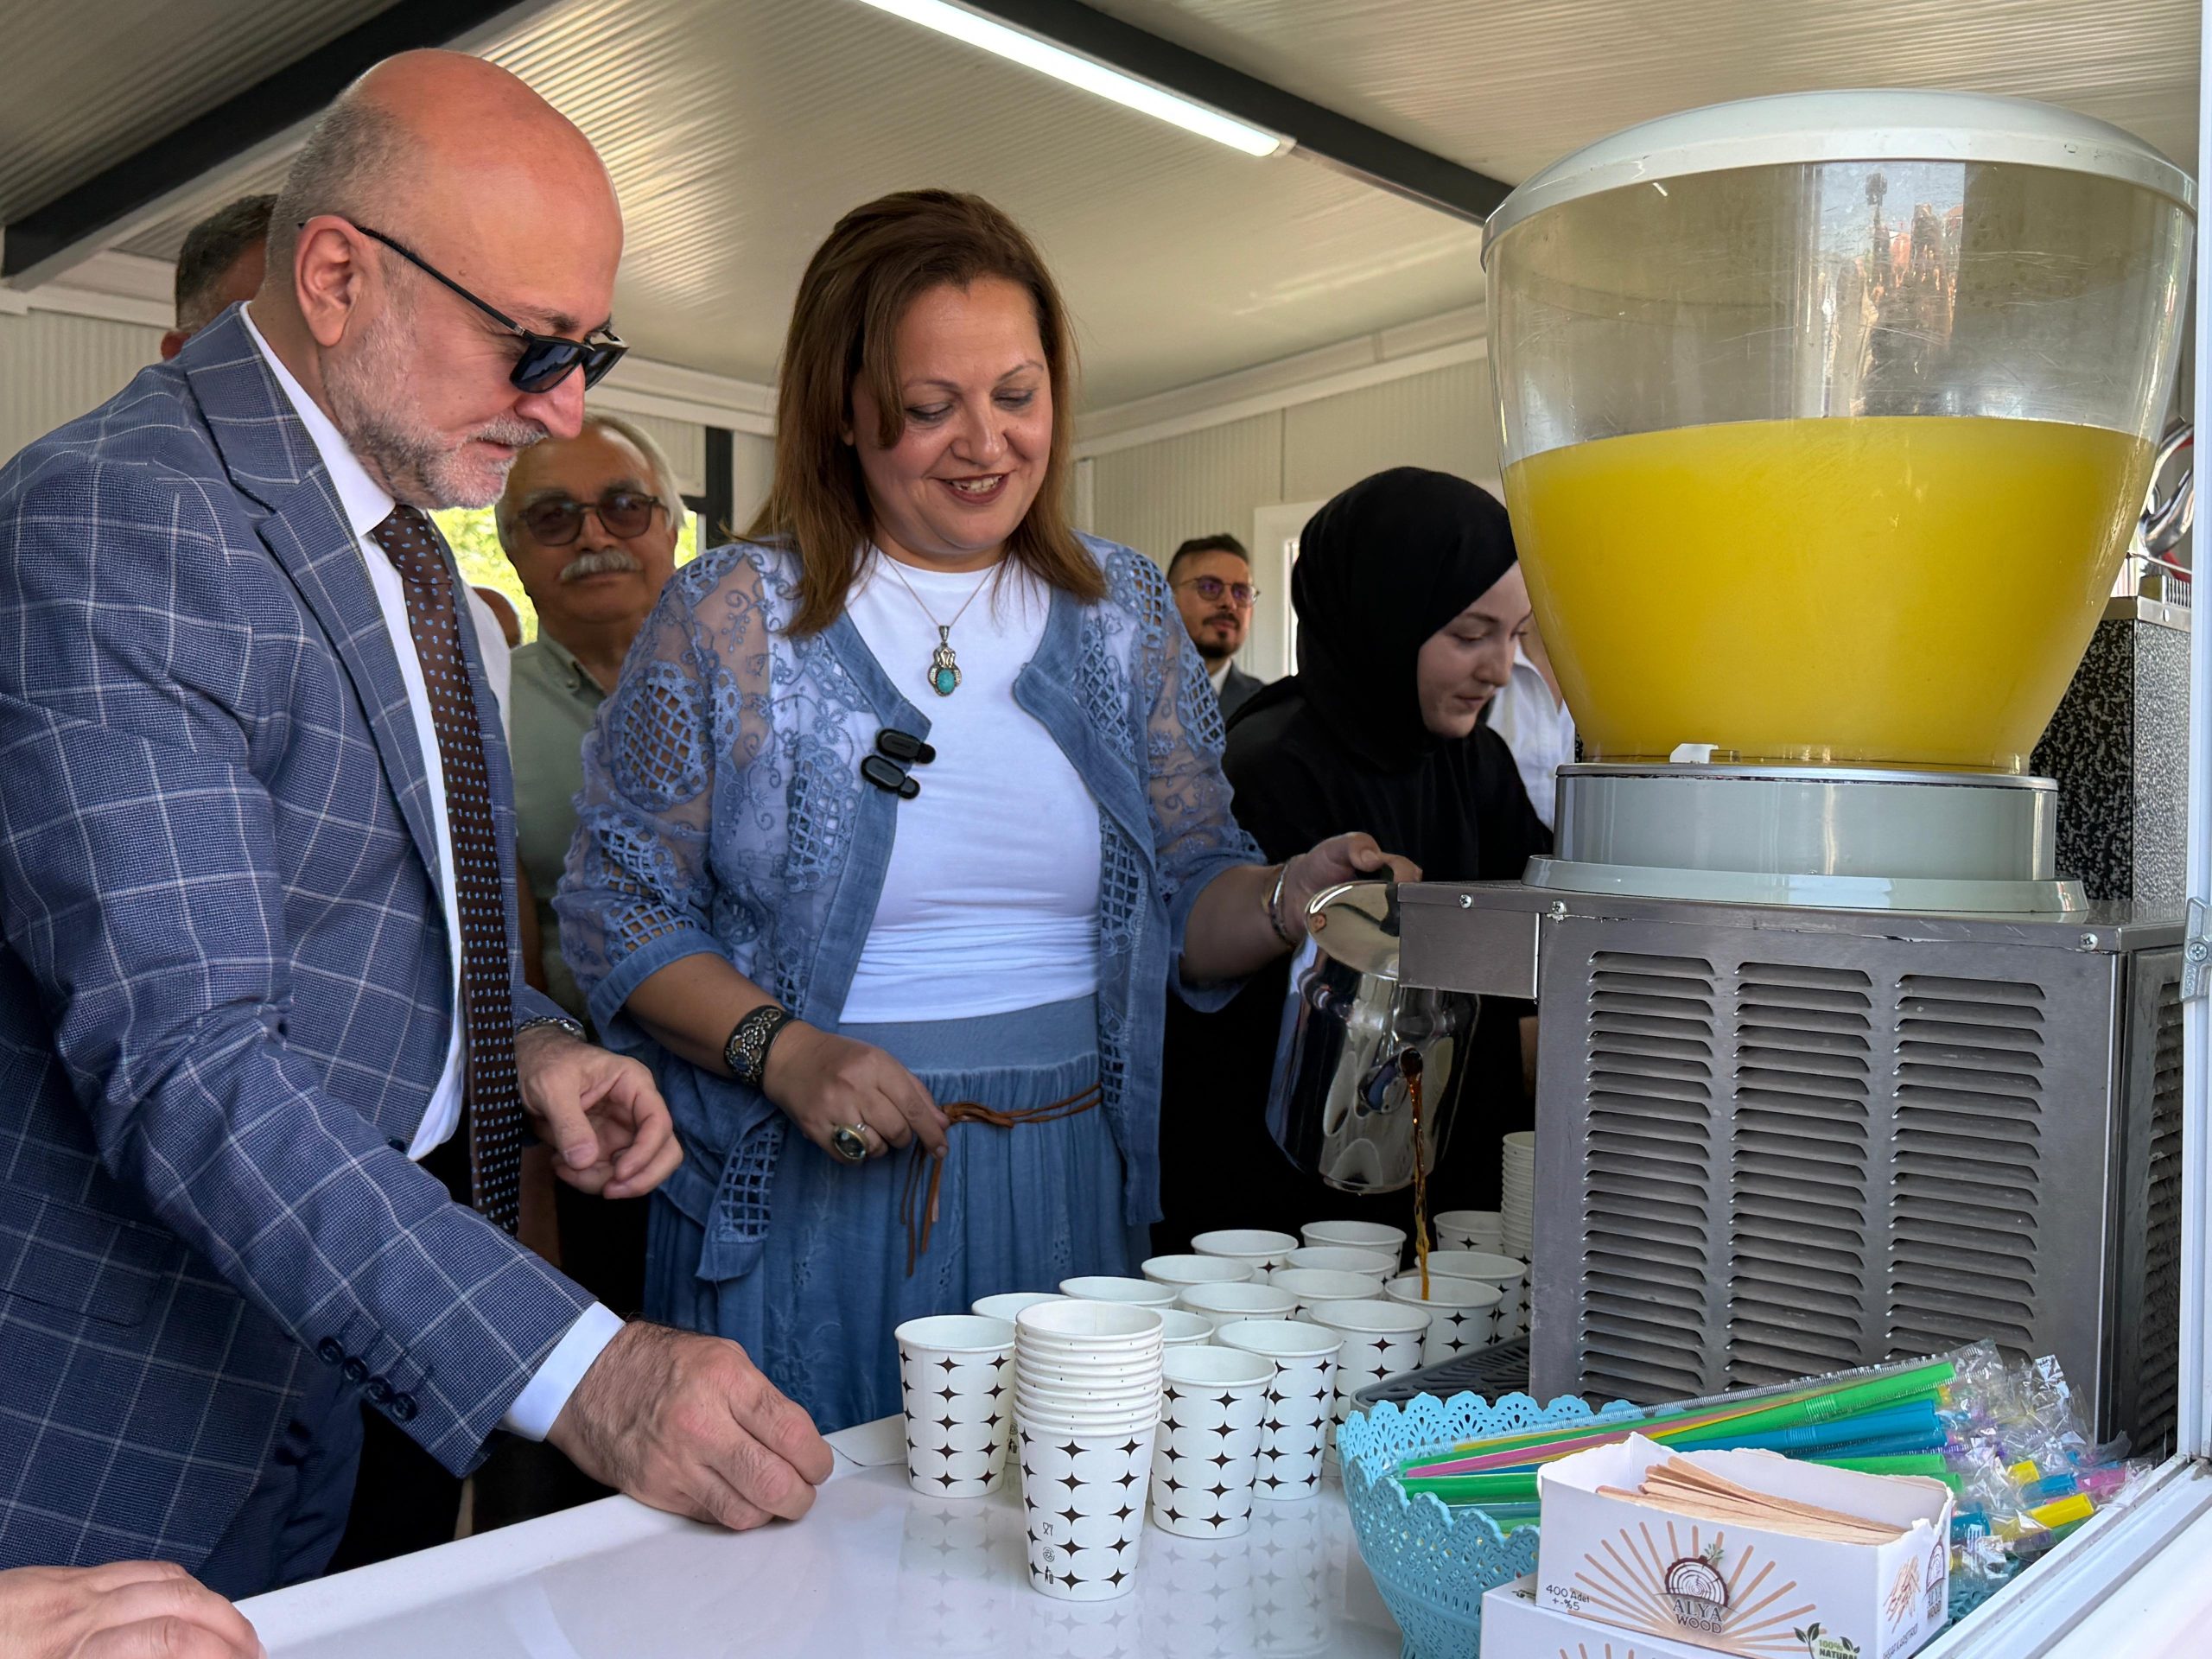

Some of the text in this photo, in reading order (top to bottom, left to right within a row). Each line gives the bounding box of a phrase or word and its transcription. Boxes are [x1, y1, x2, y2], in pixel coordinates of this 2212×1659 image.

[1546, 1585, 1568, 1598] 400
[1673, 1599, 1722, 1622] ALYA
[1675, 1614, 1722, 1634] WOOD
[1819, 1639, 1844, 1651] 100%
